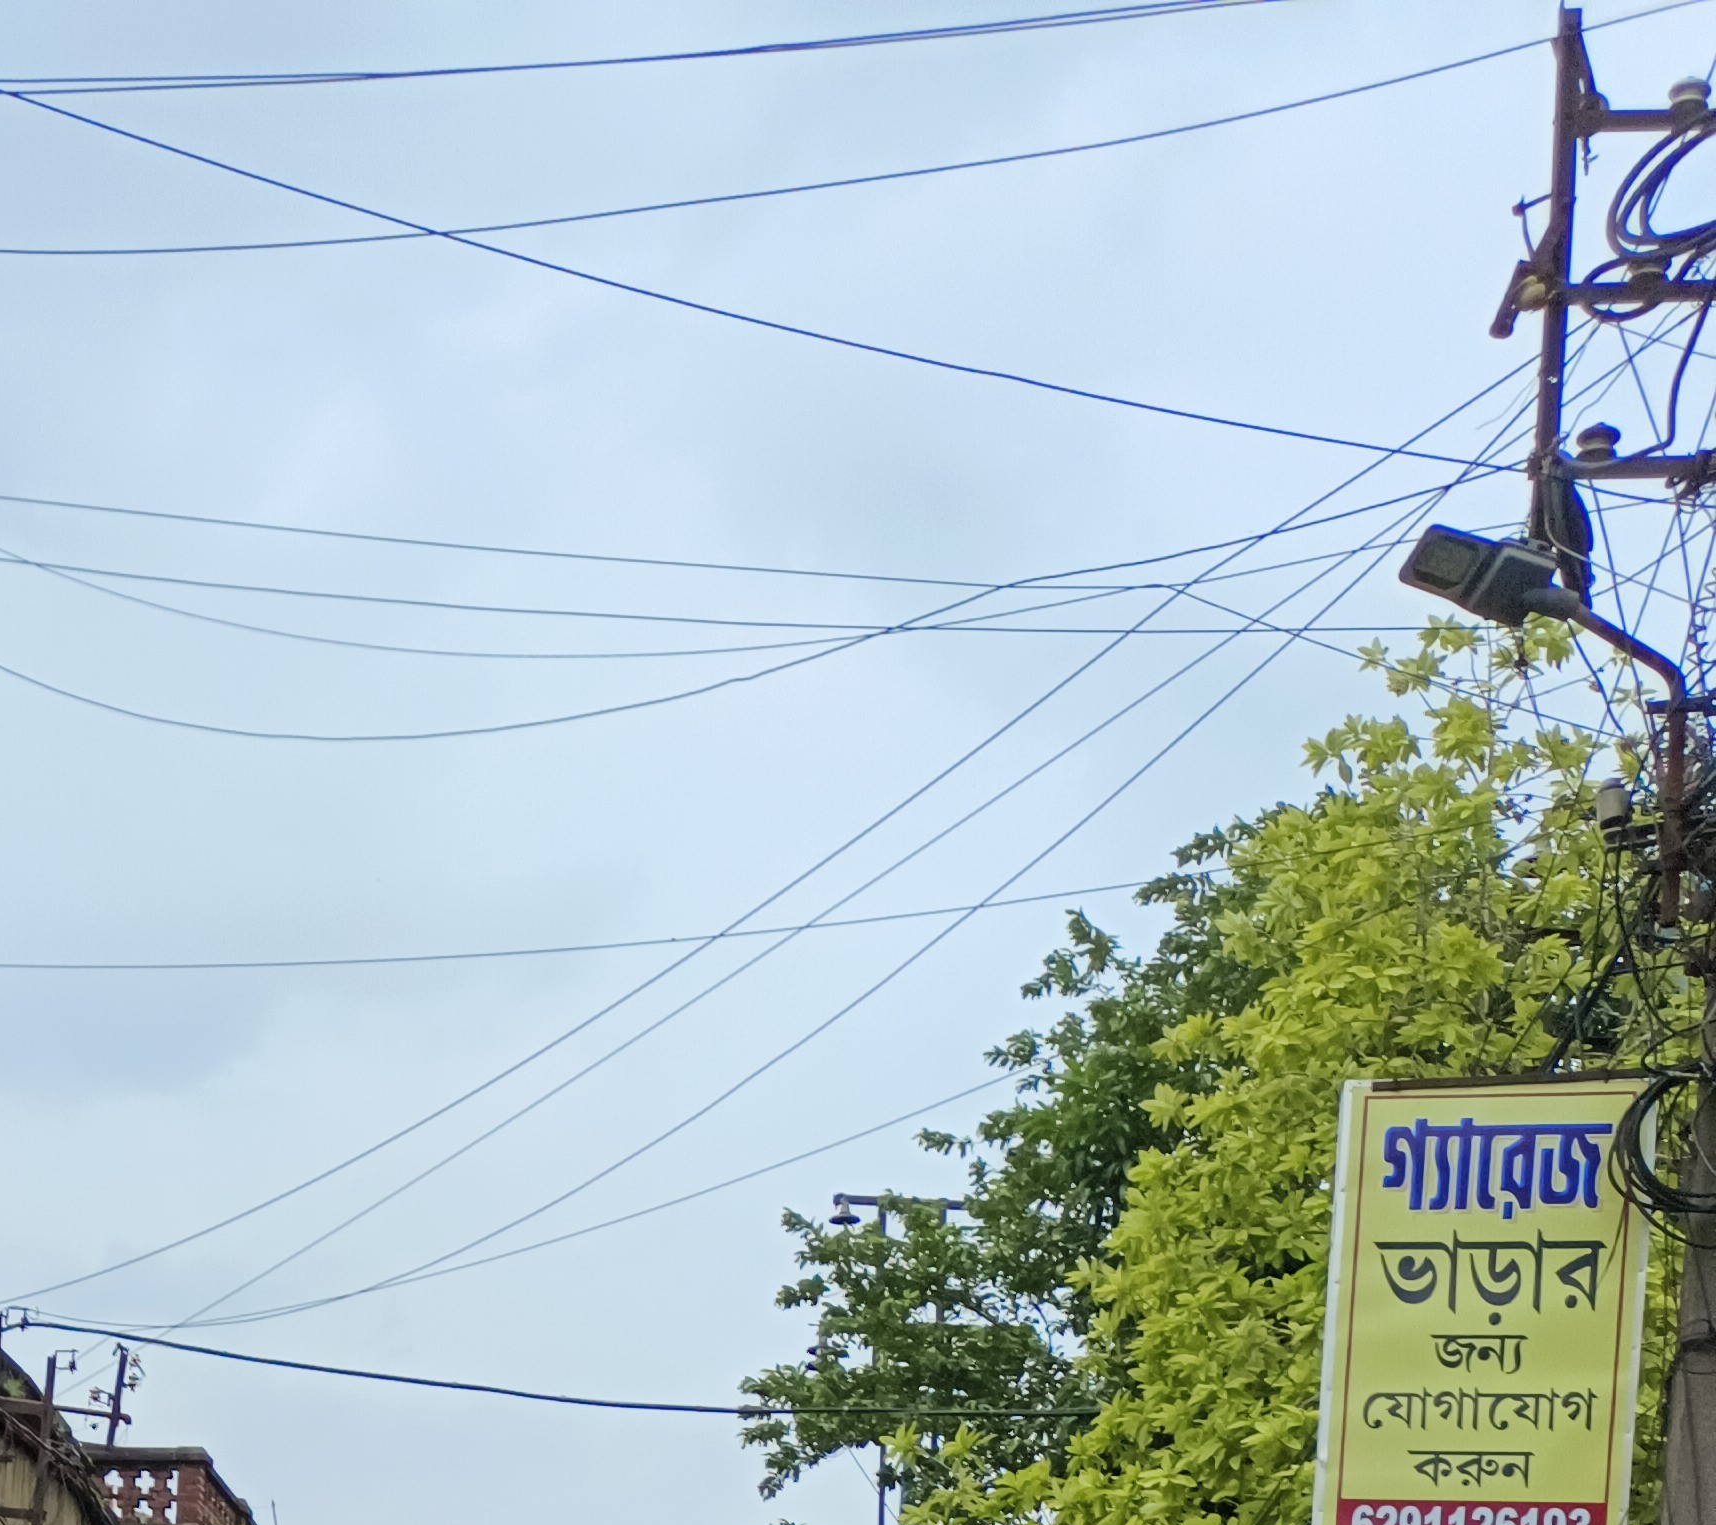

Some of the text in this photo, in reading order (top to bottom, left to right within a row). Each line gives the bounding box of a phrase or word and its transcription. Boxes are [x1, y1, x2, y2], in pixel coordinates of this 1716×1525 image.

[1382, 1117, 1615, 1220] গ্যারেজ
[1374, 1229, 1609, 1327] ভাড়ার
[1430, 1334, 1528, 1374] জন্য
[1362, 1386, 1598, 1431] যোগাযোগ
[1408, 1449, 1535, 1488] করুন
